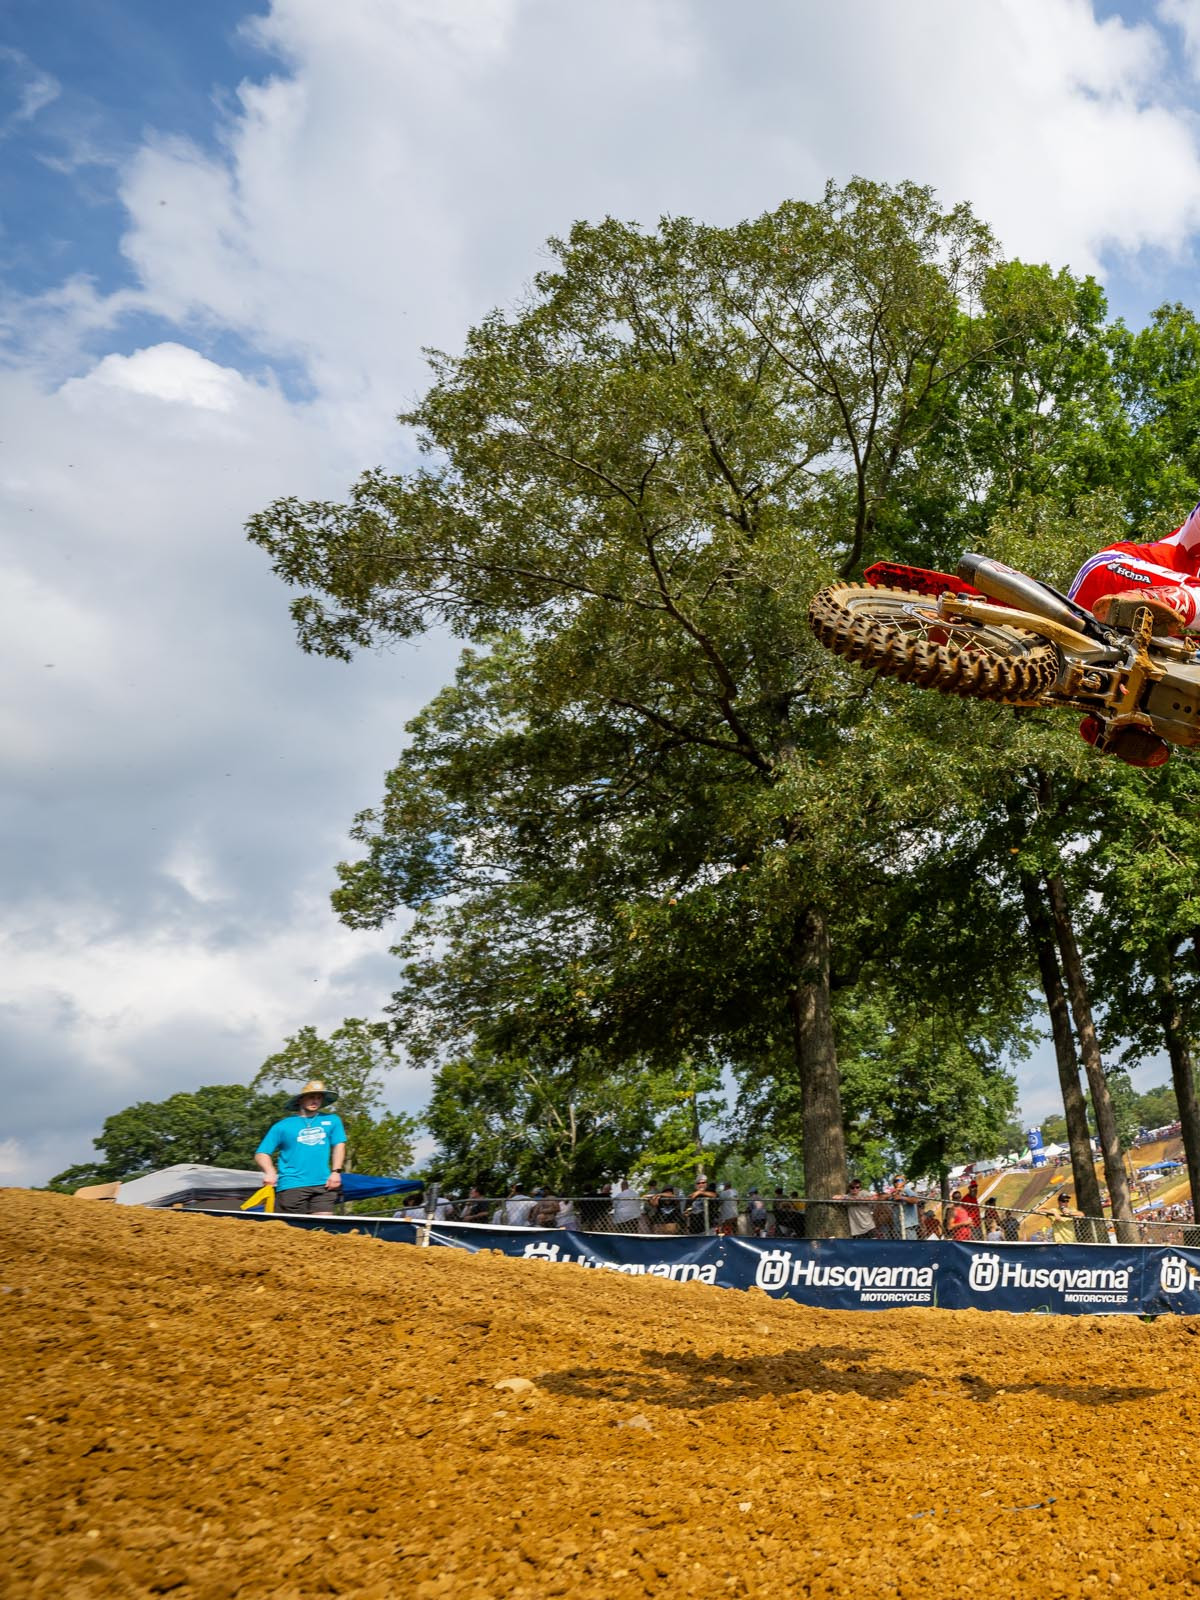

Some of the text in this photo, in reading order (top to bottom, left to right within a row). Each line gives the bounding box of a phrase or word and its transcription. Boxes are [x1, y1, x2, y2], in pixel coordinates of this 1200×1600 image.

[791, 1260, 932, 1291] Husqvarna
[1001, 1263, 1129, 1292] Husqvarna
[860, 1293, 931, 1302] MOTORCYCLES
[1064, 1294, 1128, 1303] MOTORCYCLES
